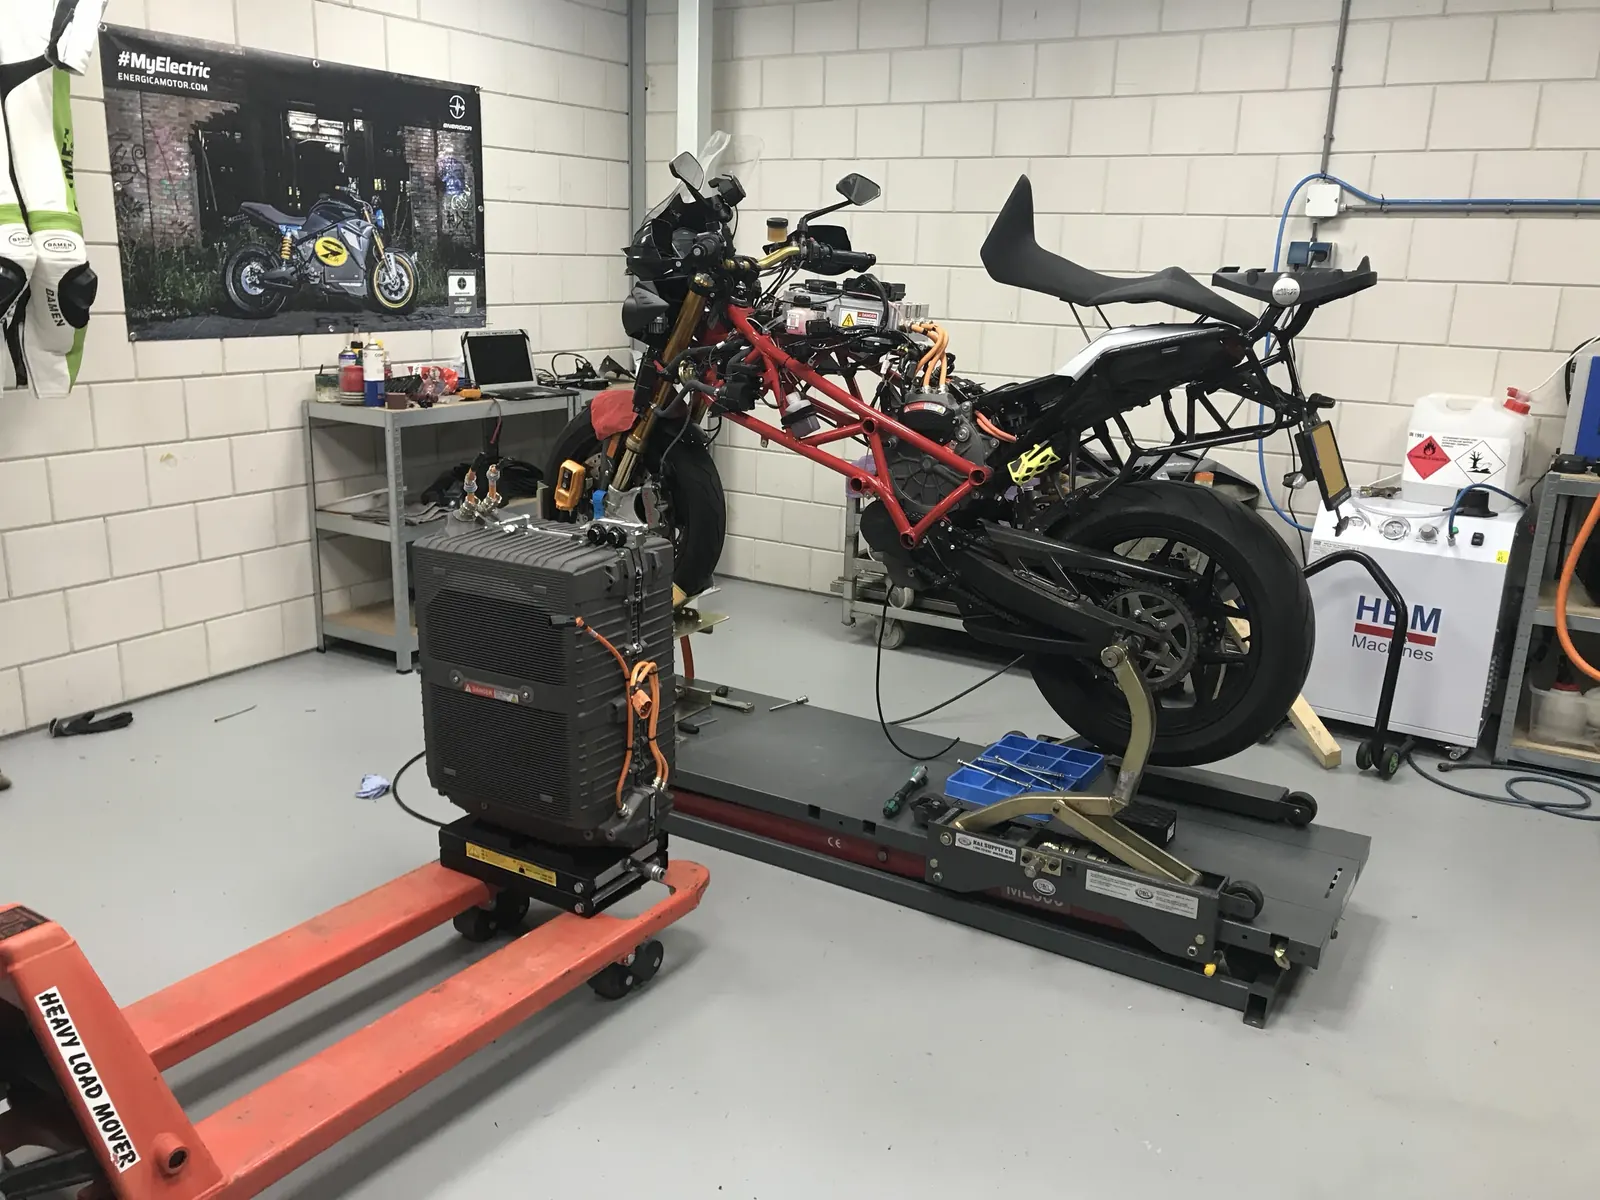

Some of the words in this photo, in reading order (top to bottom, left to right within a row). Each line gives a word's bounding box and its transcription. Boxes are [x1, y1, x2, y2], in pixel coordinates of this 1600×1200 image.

[118, 51, 211, 79] #MyElectric
[117, 72, 209, 92] ENERGICAMOTOR.COM
[45, 287, 66, 327] DAMEN
[984, 843, 1005, 853] SUPPLY
[38, 992, 81, 1048] HEAVY
[68, 1052, 103, 1099] LOAD
[92, 1103, 136, 1168] MOVER
